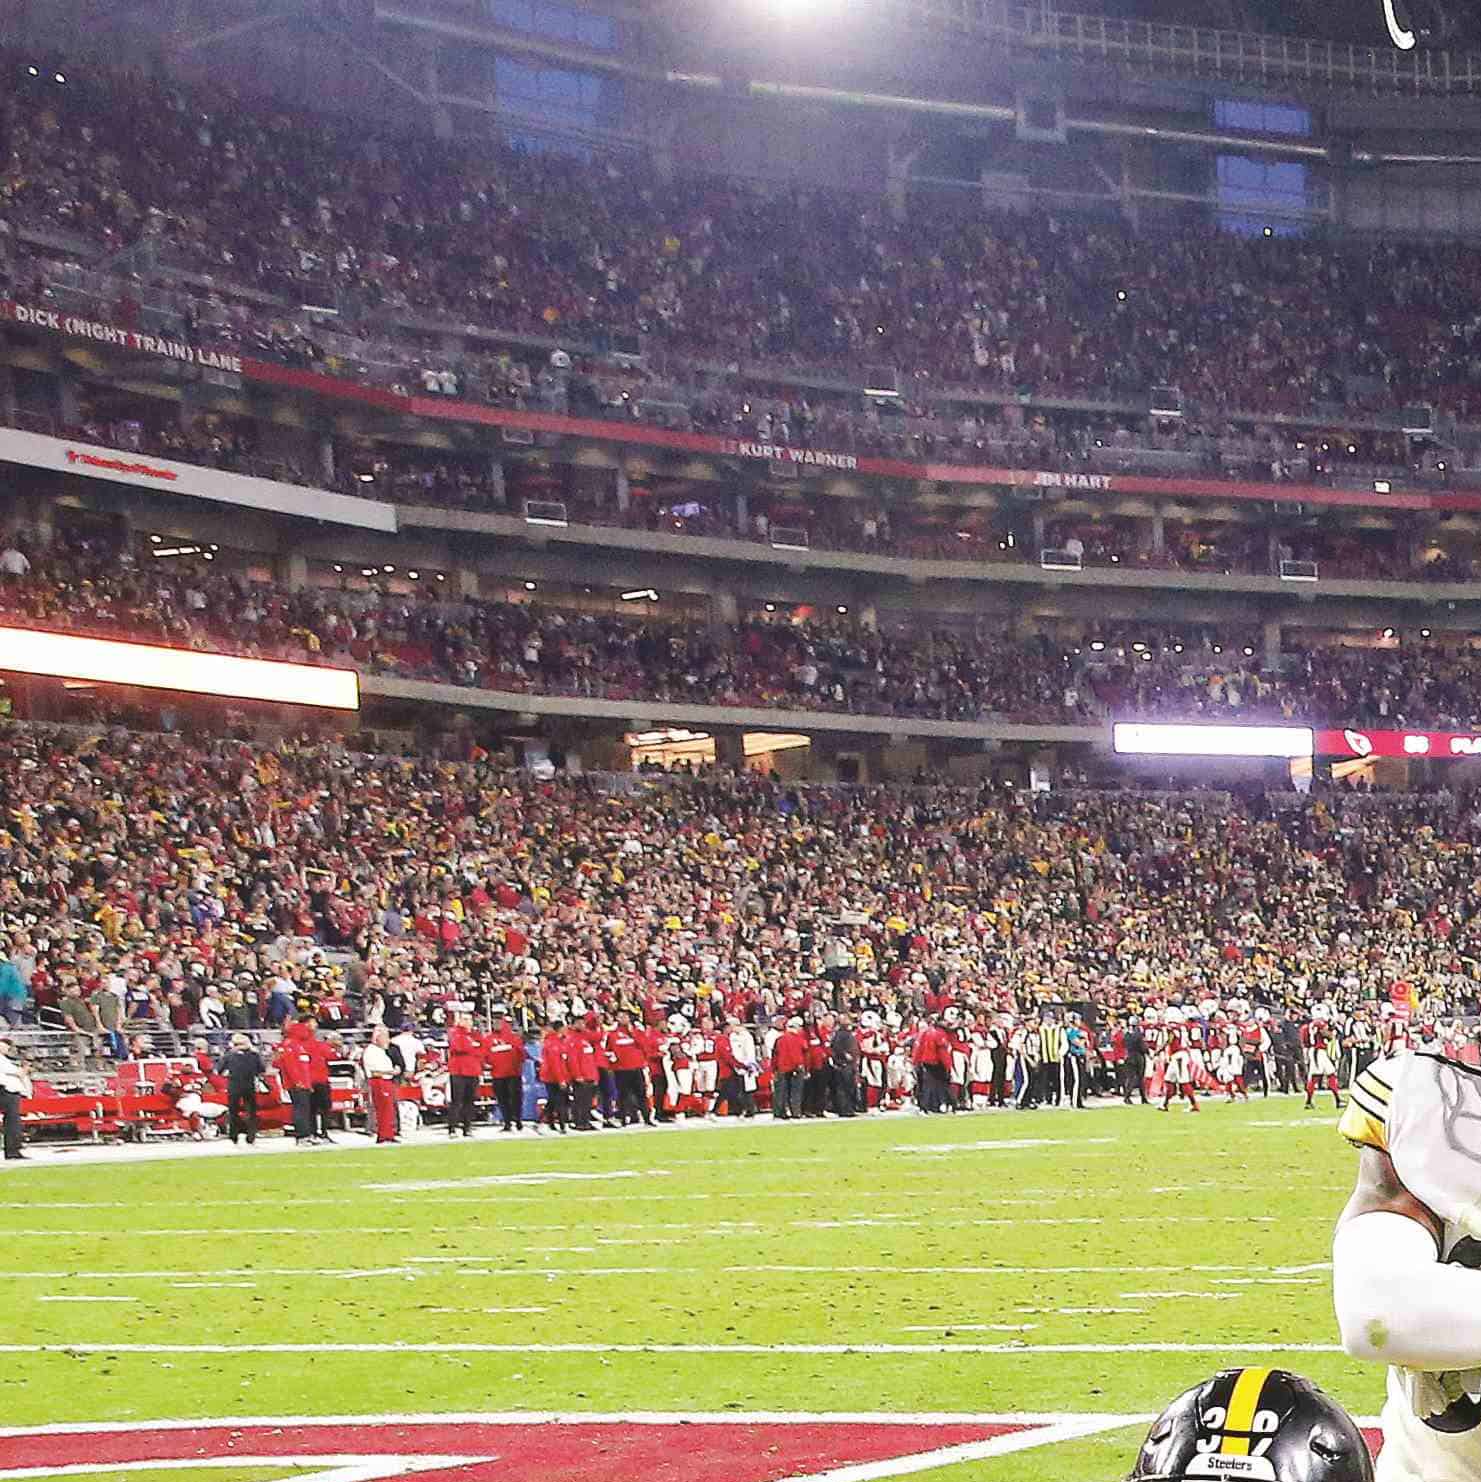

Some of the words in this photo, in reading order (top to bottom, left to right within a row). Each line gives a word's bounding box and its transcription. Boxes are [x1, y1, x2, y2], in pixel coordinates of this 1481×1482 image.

[16, 305, 61, 330] DICK
[198, 348, 243, 373] LANE
[739, 441, 784, 459] KURT
[1196, 1406, 1281, 1457] 39
[1207, 1456, 1254, 1472] Steelers
